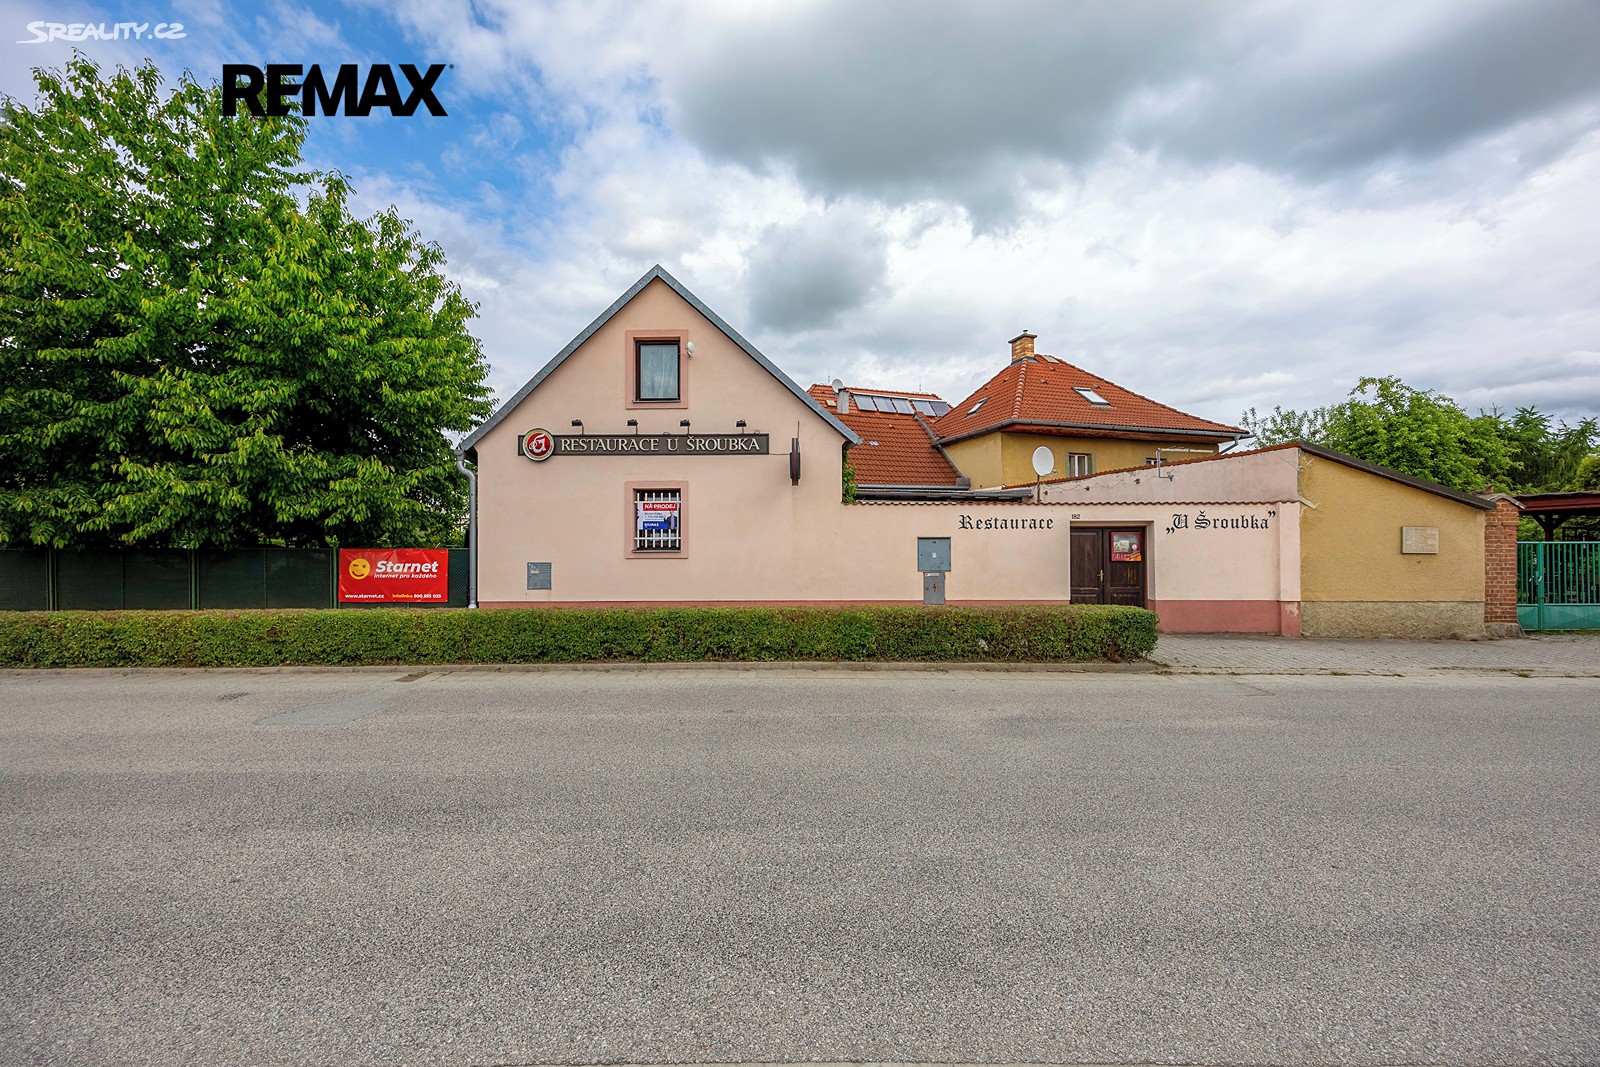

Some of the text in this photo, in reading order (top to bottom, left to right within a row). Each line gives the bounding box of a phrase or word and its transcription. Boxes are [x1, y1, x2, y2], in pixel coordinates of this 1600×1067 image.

[561, 435, 760, 451] RESTAURACE U ŠROUBKA
[958, 514, 1054, 530] Restaurace
[375, 560, 439, 573] Starnet
